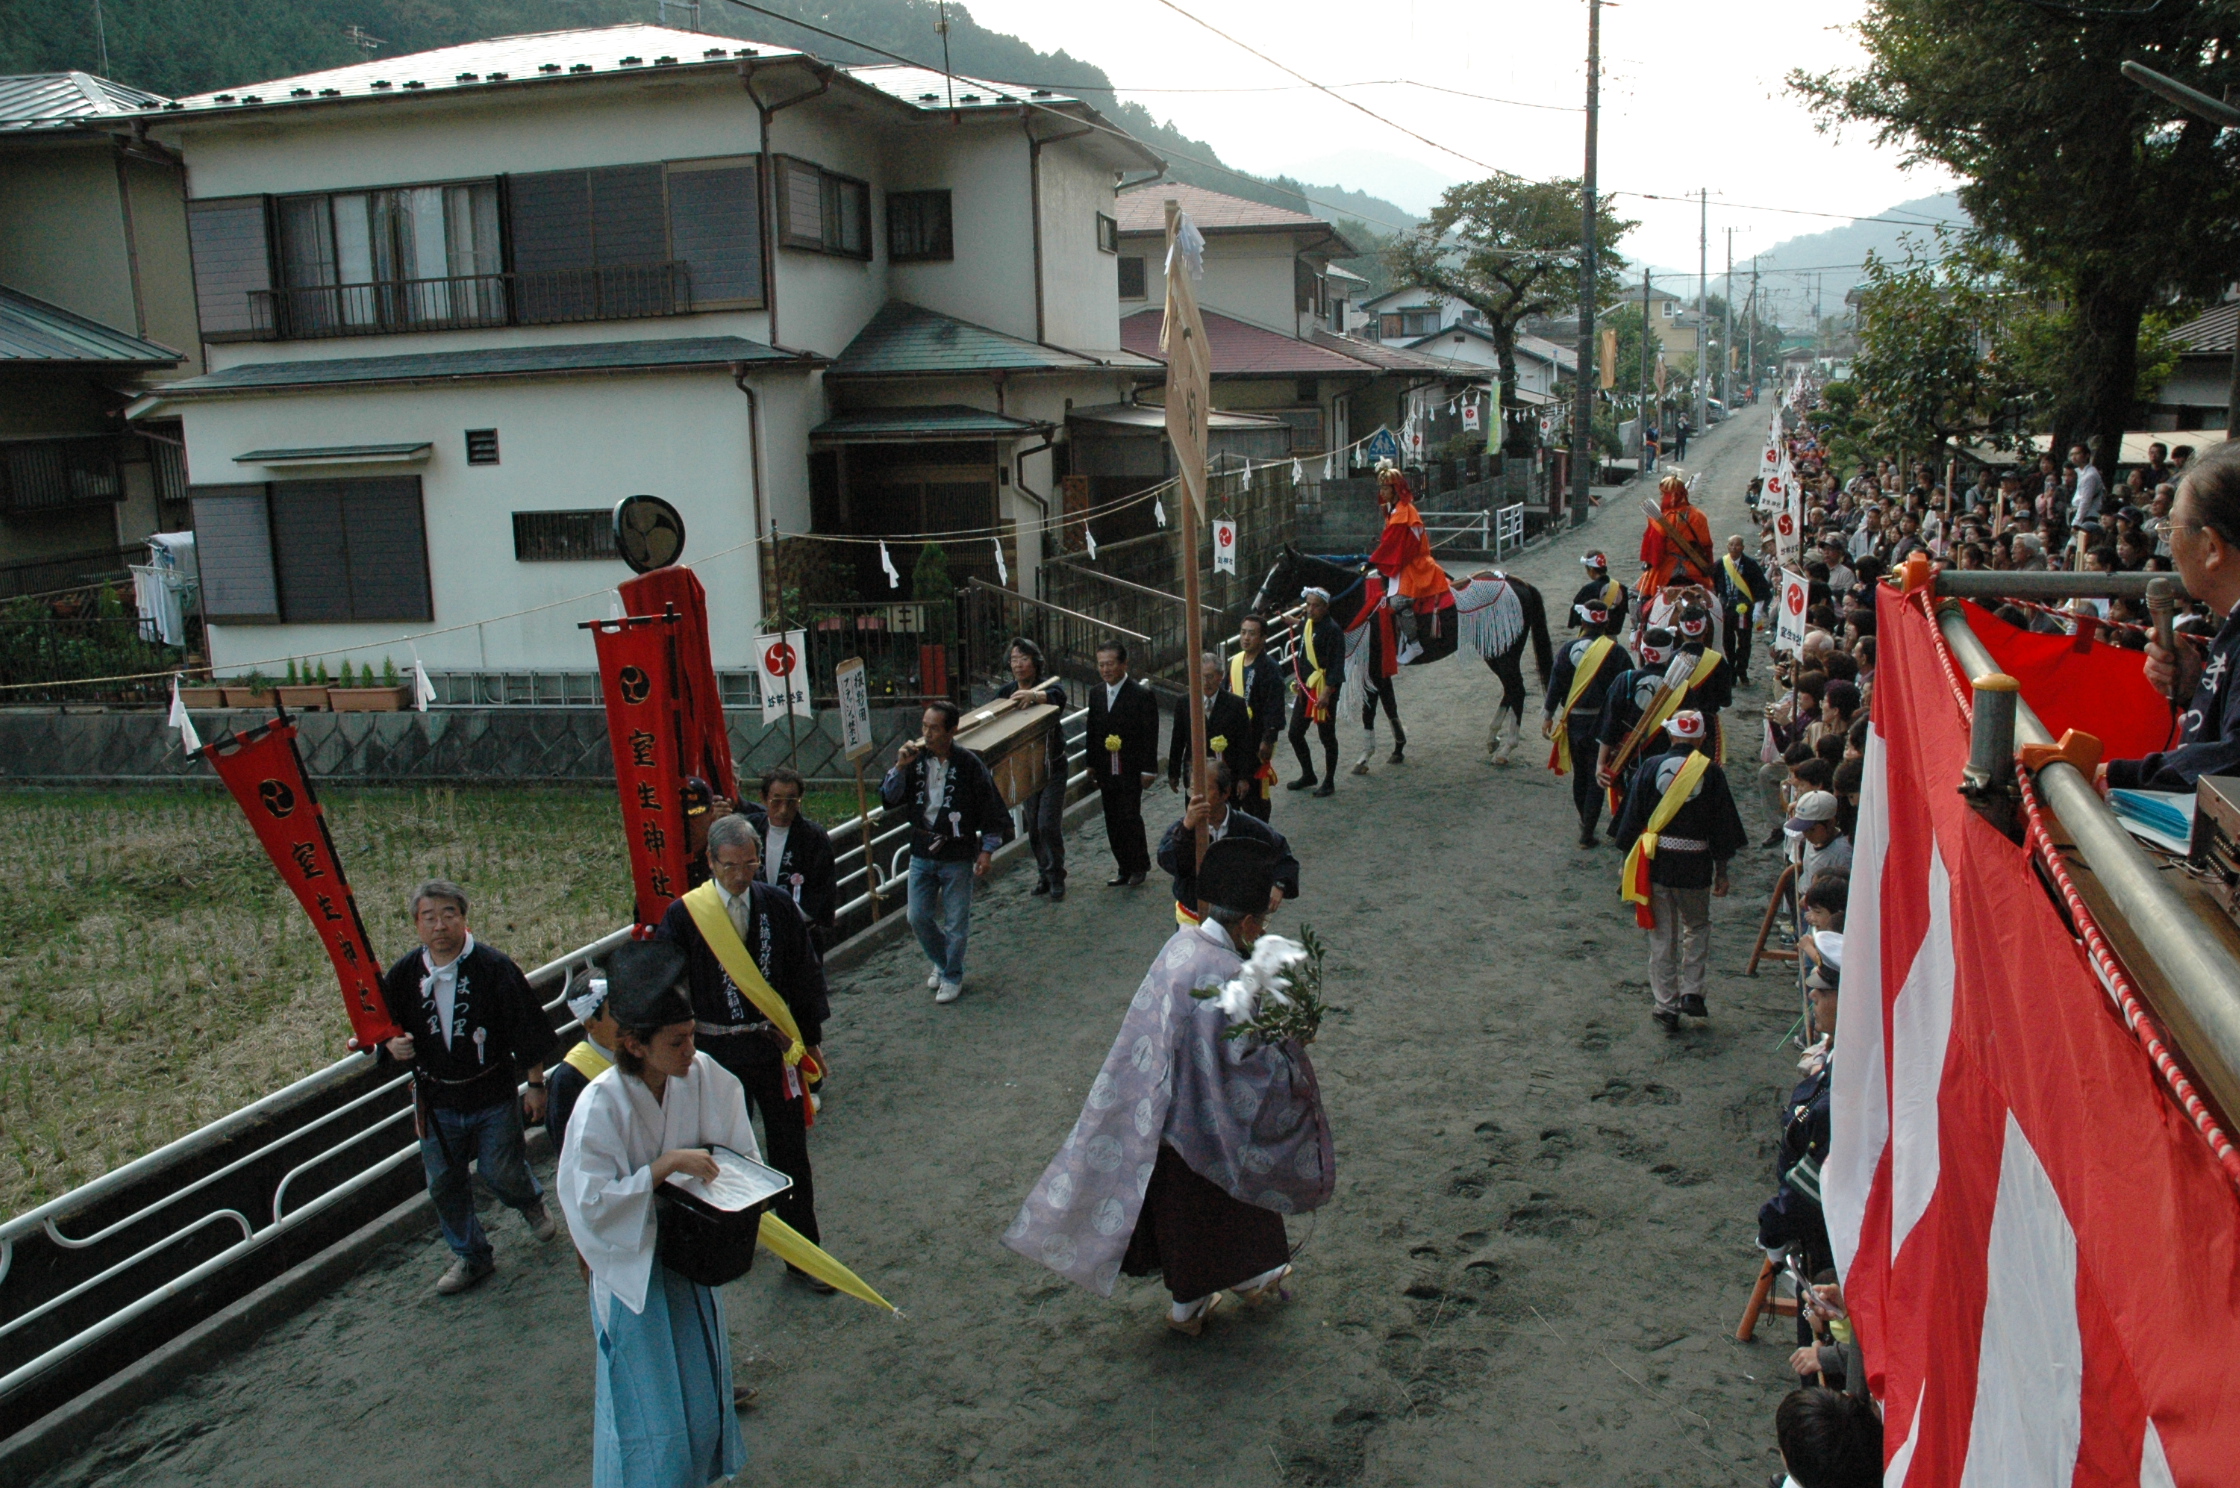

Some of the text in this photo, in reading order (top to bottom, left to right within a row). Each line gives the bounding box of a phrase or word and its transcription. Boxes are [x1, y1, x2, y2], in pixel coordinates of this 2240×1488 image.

[628, 728, 675, 899] 室生神社
[943, 767, 957, 808] まつ里
[291, 840, 377, 1013] 室生神社
[420, 973, 441, 1035] つ里
[453, 975, 471, 1037] まつ里
